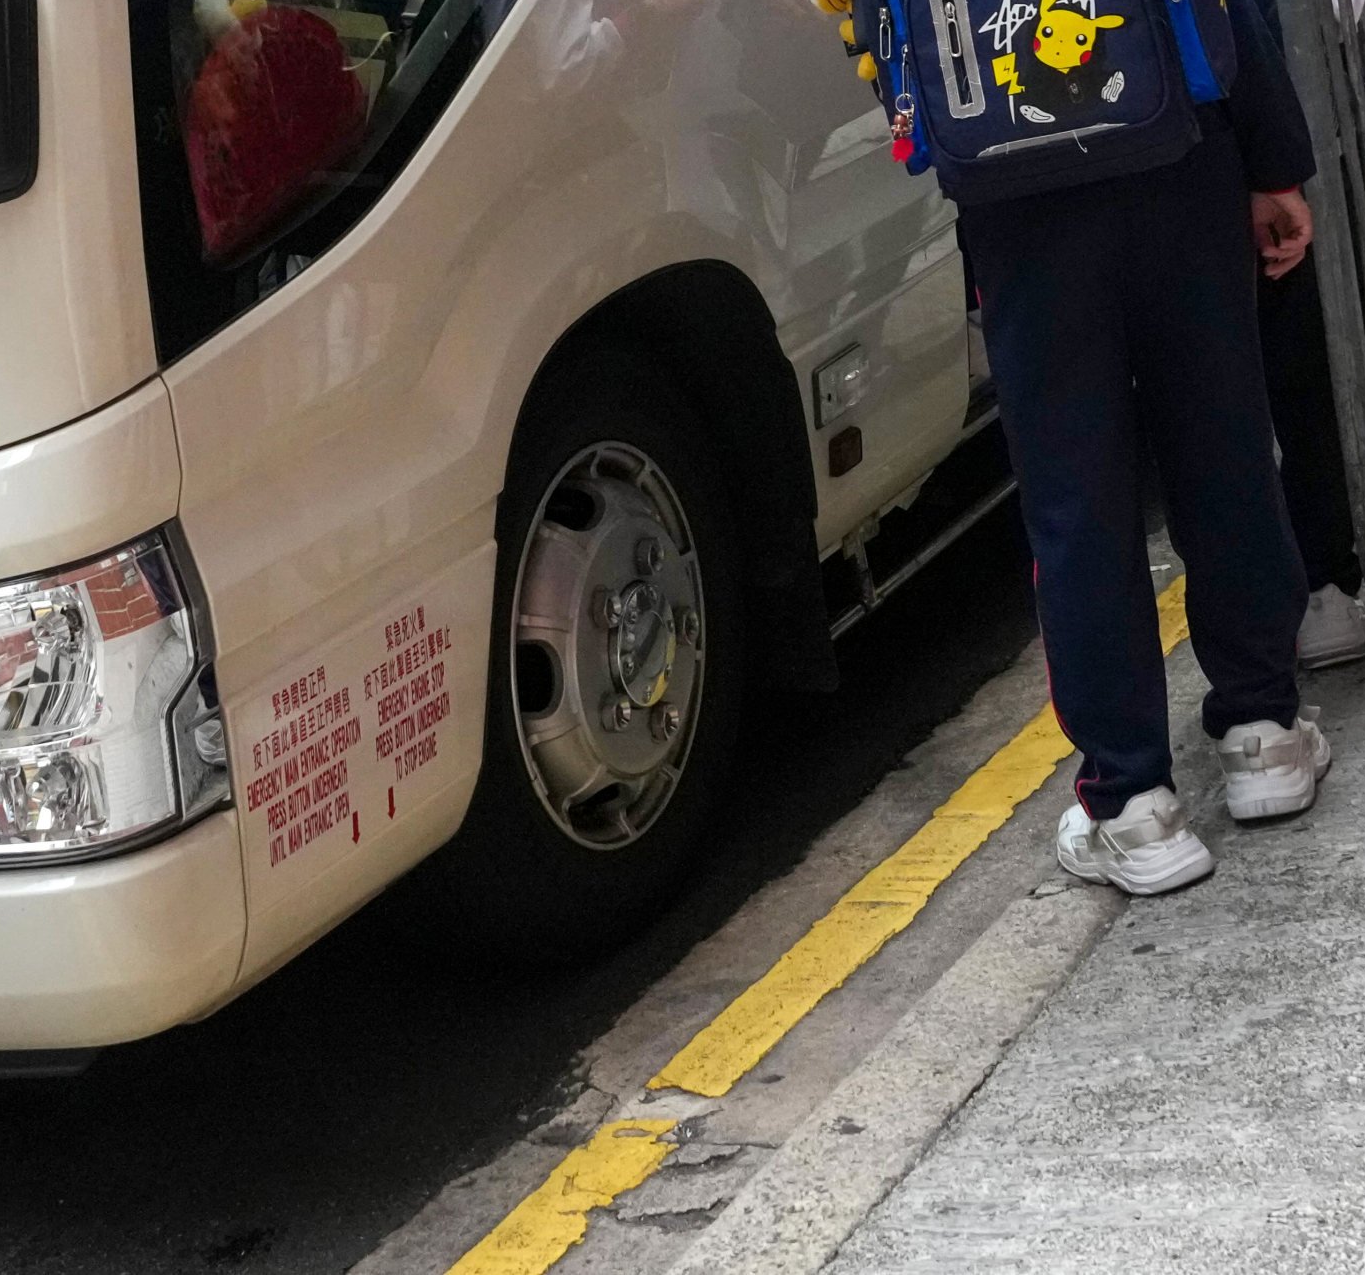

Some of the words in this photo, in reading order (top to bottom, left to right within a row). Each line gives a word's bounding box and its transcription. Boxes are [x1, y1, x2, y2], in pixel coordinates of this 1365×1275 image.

[375, 725, 394, 762] PRESS
[394, 711, 416, 750] BUTTON
[416, 691, 451, 736] UNDERNEATH
[377, 681, 410, 727] EMERGENCY
[410, 669, 431, 706] ENGINE
[431, 661, 445, 692] STOP
[246, 767, 283, 812] EMERGENCY
[284, 755, 300, 789] MAIN
[300, 741, 331, 779] ENTRANCE
[331, 716, 362, 759] OPERATION
[395, 754, 403, 783] TO
[404, 744, 418, 777] STOP
[417, 731, 438, 768] ENGINE
[267, 799, 287, 836] PRESS
[287, 784, 311, 824] BUTTON
[312, 758, 348, 805] UNDERNEATH
[269, 833, 287, 868] UNTIL
[288, 822, 303, 856] MAIN
[304, 802, 334, 845] ENTRANCE
[335, 790, 350, 824] OPEN
